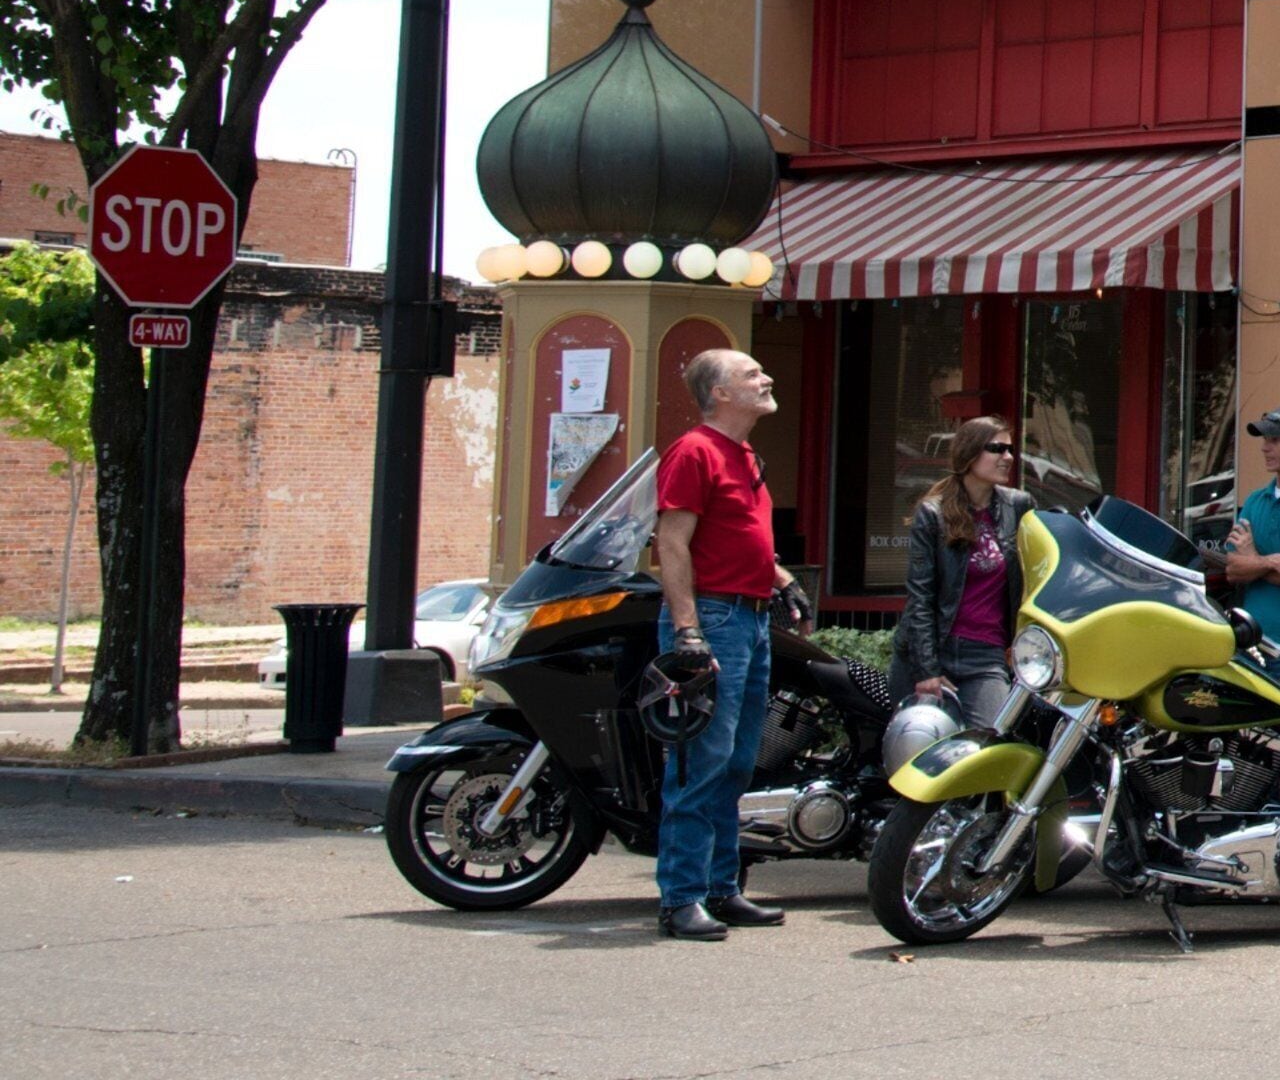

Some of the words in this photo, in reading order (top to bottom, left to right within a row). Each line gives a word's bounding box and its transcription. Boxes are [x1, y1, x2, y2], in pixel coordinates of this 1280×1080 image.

[101, 194, 226, 257] STOP
[134, 324, 185, 341] 4-WAY
[870, 536, 889, 547] BOX
[891, 536, 911, 548] OFFI
